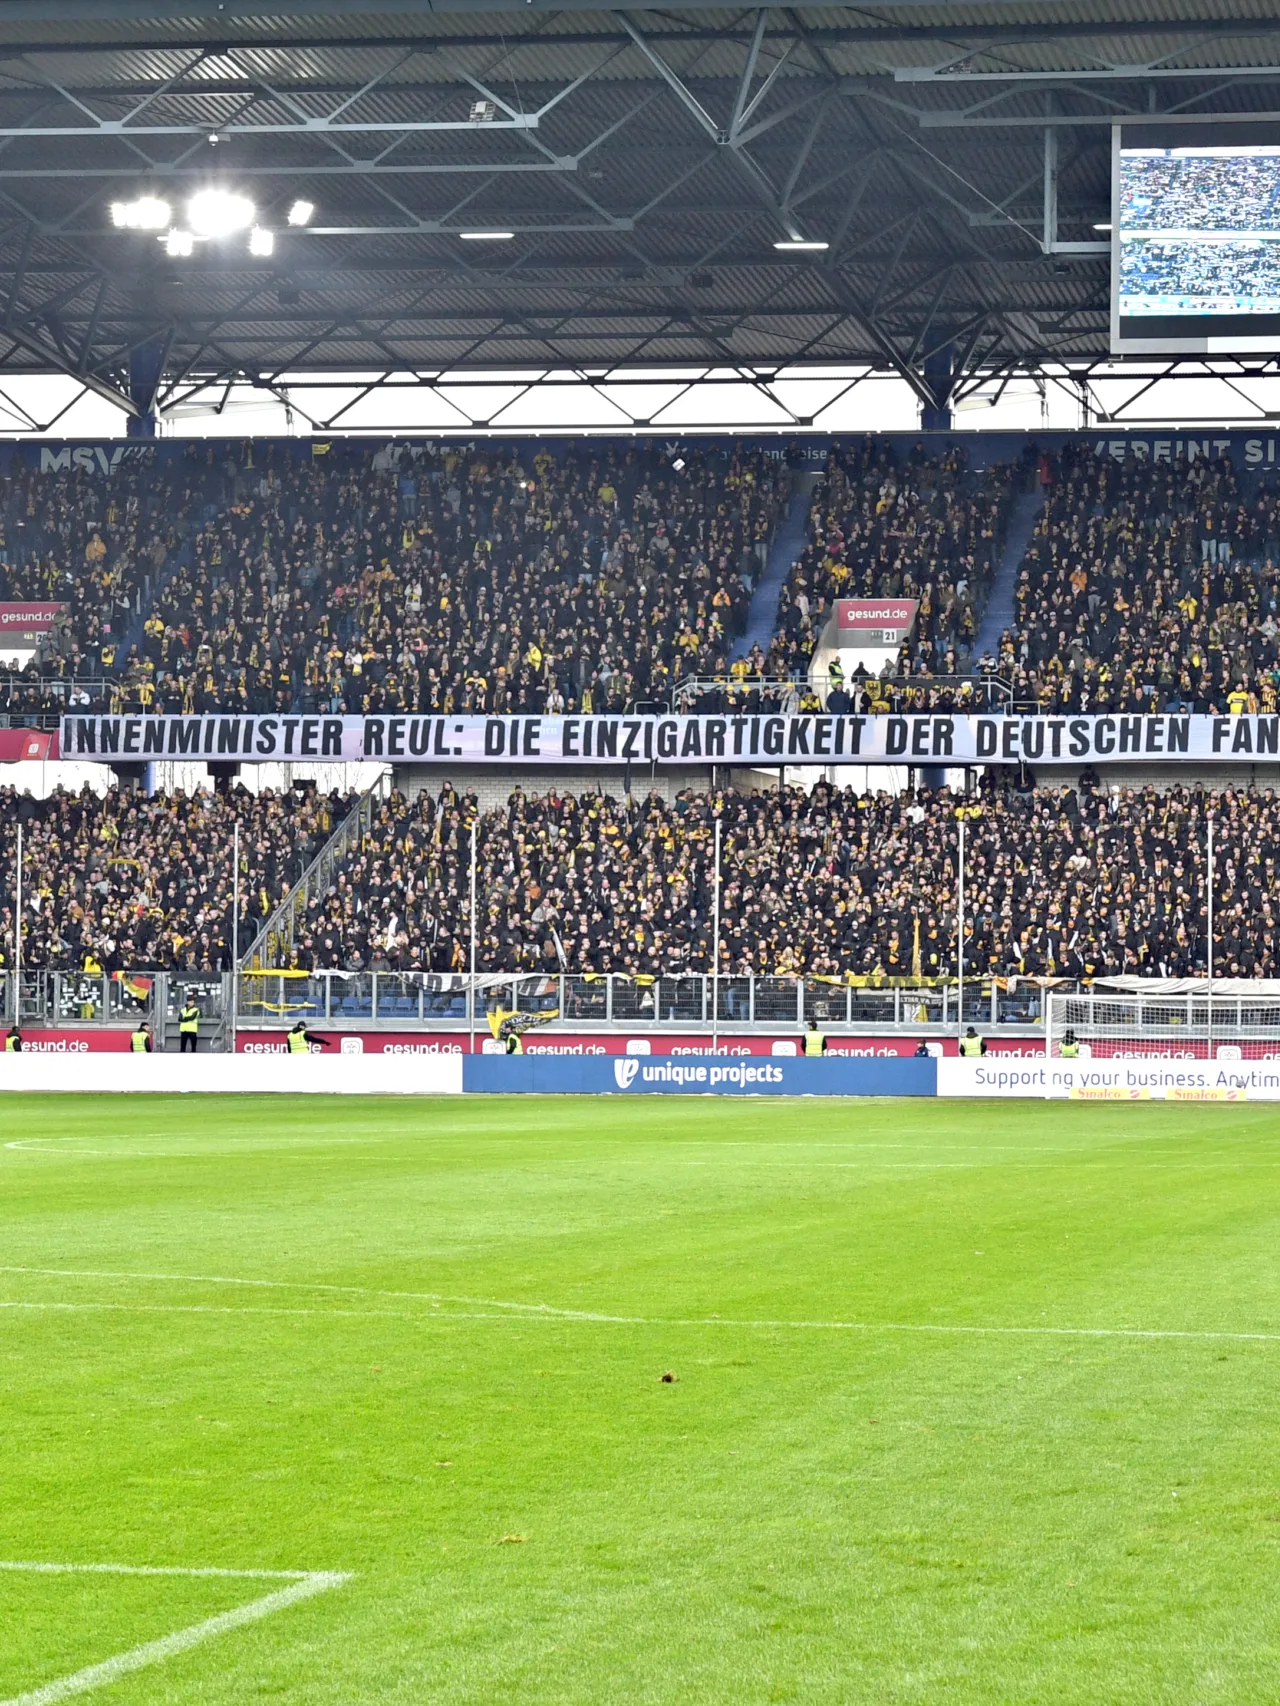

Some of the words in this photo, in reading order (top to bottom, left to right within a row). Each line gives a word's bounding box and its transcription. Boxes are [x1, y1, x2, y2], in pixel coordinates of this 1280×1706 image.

[40, 447, 124, 476] MSV
[847, 608, 908, 621] gesund.de
[885, 631, 895, 641] 21
[63, 718, 344, 756] INNENMINISTER
[363, 718, 465, 756] REUL:
[484, 718, 541, 756] DIE
[562, 716, 867, 759] EINZIGARTIGKEIT
[885, 717, 955, 756] DER
[976, 717, 1190, 759] DEUTSCHEN
[21, 1040, 89, 1052] esund.de
[383, 1042, 463, 1054] gesund.de
[671, 1045, 752, 1056] gesundde
[1112, 1049, 1195, 1059] gesundde
[642, 1061, 707, 1086] unique
[710, 1063, 783, 1088] projects
[975, 1067, 1074, 1089] Supportng
[1079, 1073, 1120, 1088] your
[1126, 1069, 1210, 1087] business.
[1078, 1088, 1121, 1099] Sinalco
[1174, 1089, 1218, 1100] Sinalco
